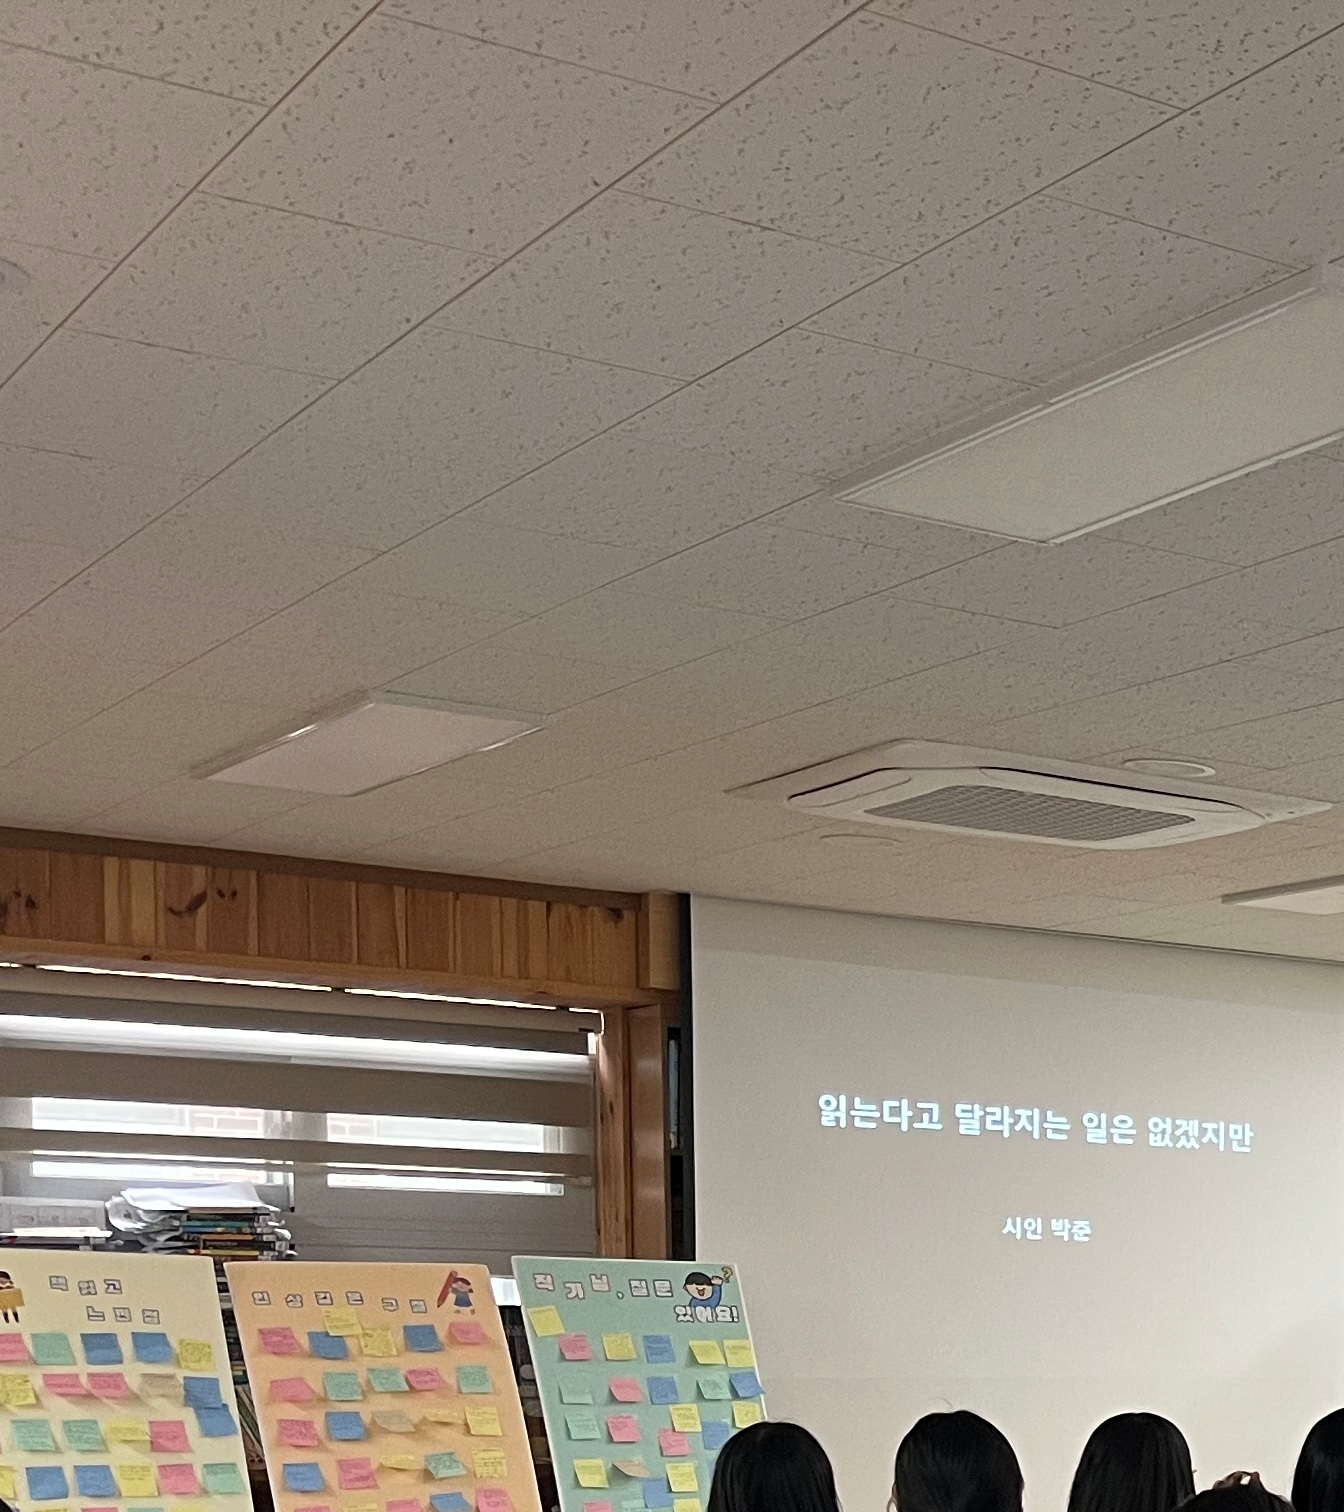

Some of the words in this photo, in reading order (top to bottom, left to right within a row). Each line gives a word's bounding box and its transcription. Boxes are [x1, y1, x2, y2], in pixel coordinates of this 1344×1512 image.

[819, 1095, 942, 1131] 읽는다고
[955, 1104, 1070, 1140] 달라지는
[1083, 1113, 1136, 1144] 일은
[1148, 1117, 1254, 1152] 없겠지만
[1002, 1217, 1042, 1239] 시인
[1051, 1219, 1091, 1241] 박준
